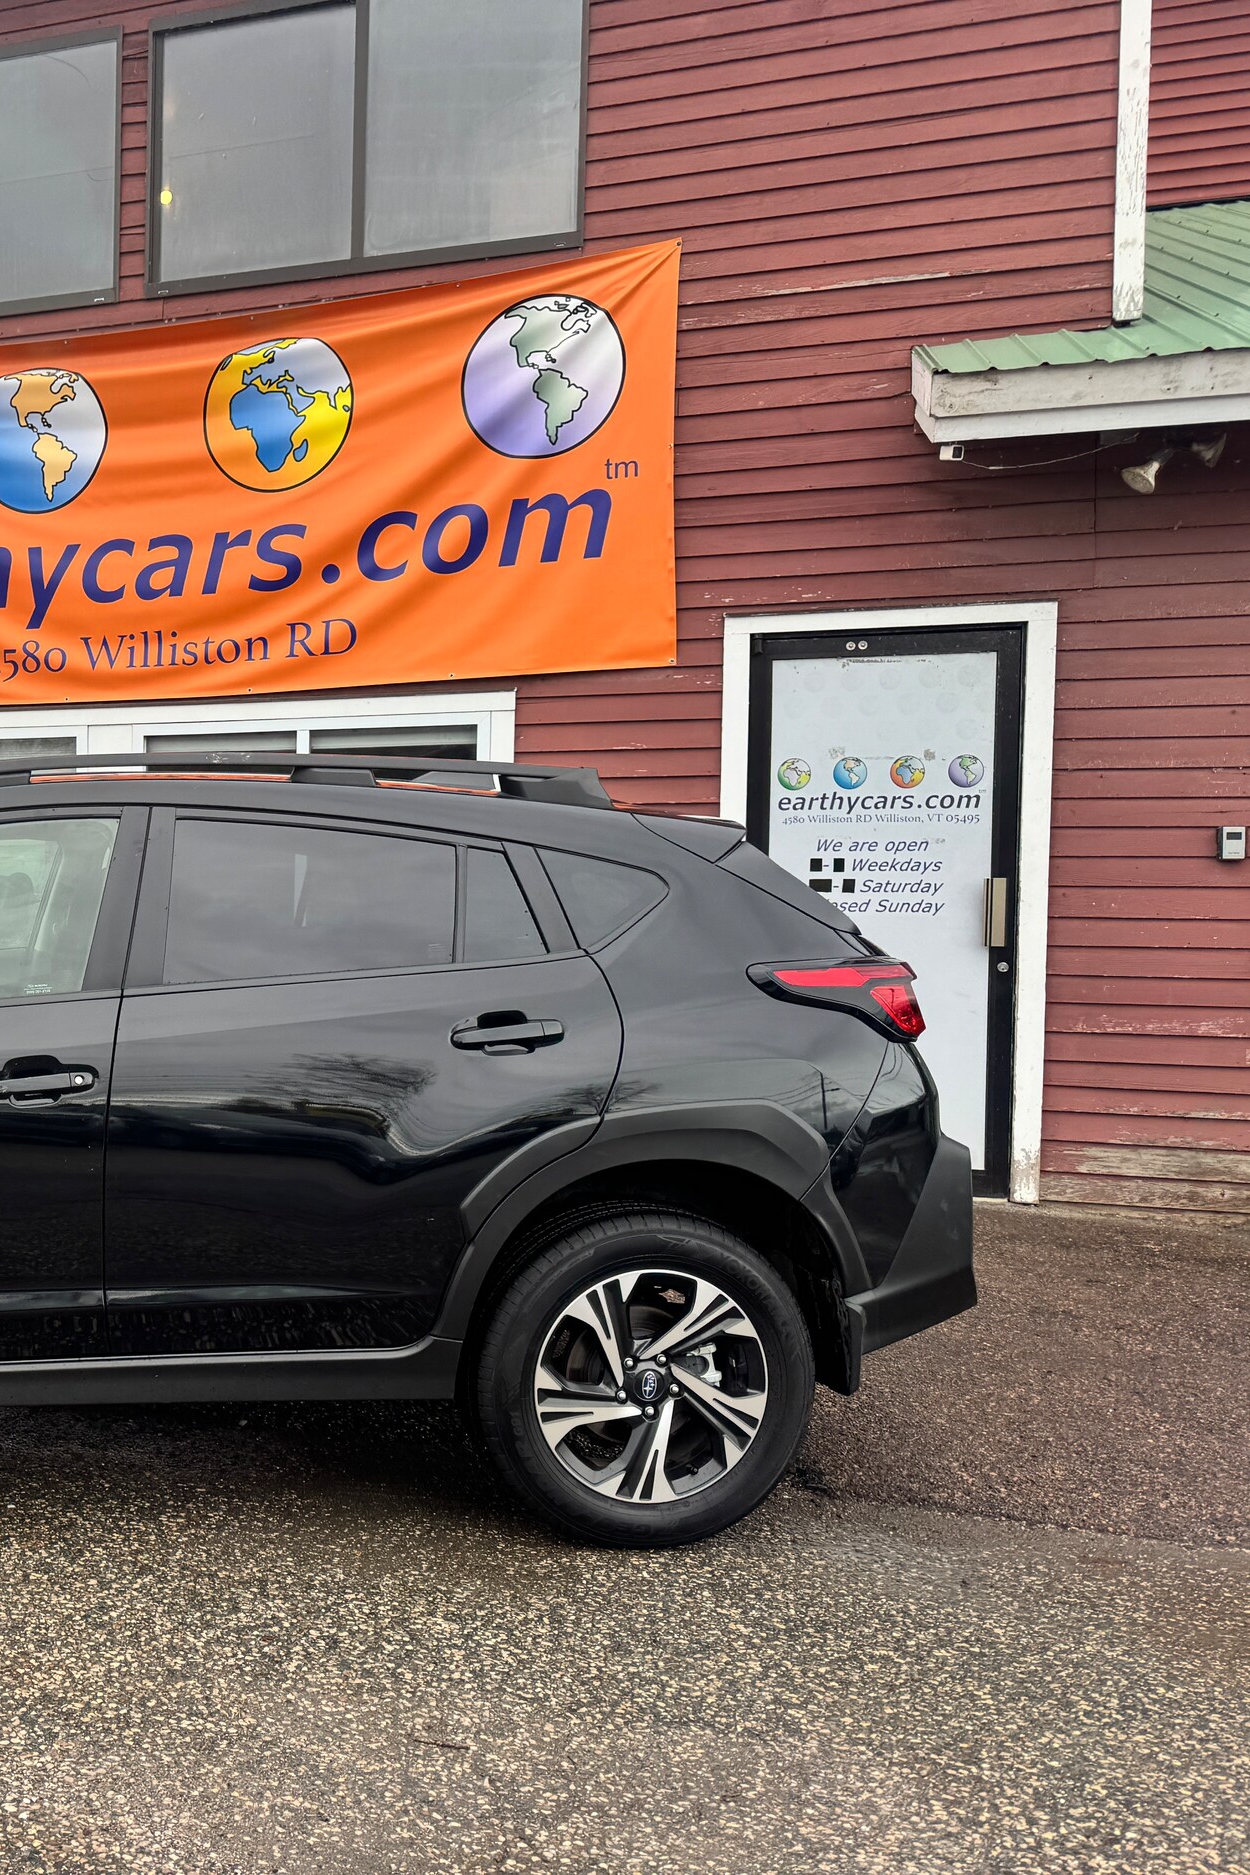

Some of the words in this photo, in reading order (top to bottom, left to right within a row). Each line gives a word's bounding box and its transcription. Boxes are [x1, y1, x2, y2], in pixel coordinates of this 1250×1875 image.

[604, 458, 639, 480] tm
[79, 630, 269, 670] Williston
[285, 617, 358, 659] RD
[777, 791, 981, 814] earthycars.com
[782, 814, 806, 824] 4580
[807, 814, 853, 824] Williston
[855, 814, 873, 823] RD
[875, 813, 924, 823] Williston,
[927, 813, 944, 822] VT
[945, 813, 981, 825] 05495
[816, 839, 843, 852] We
[848, 841, 878, 852] are
[884, 841, 929, 855] open
[851, 858, 943, 875] Weekdays
[859, 879, 944, 896] Saturday
[875, 899, 946, 916] Sunday
